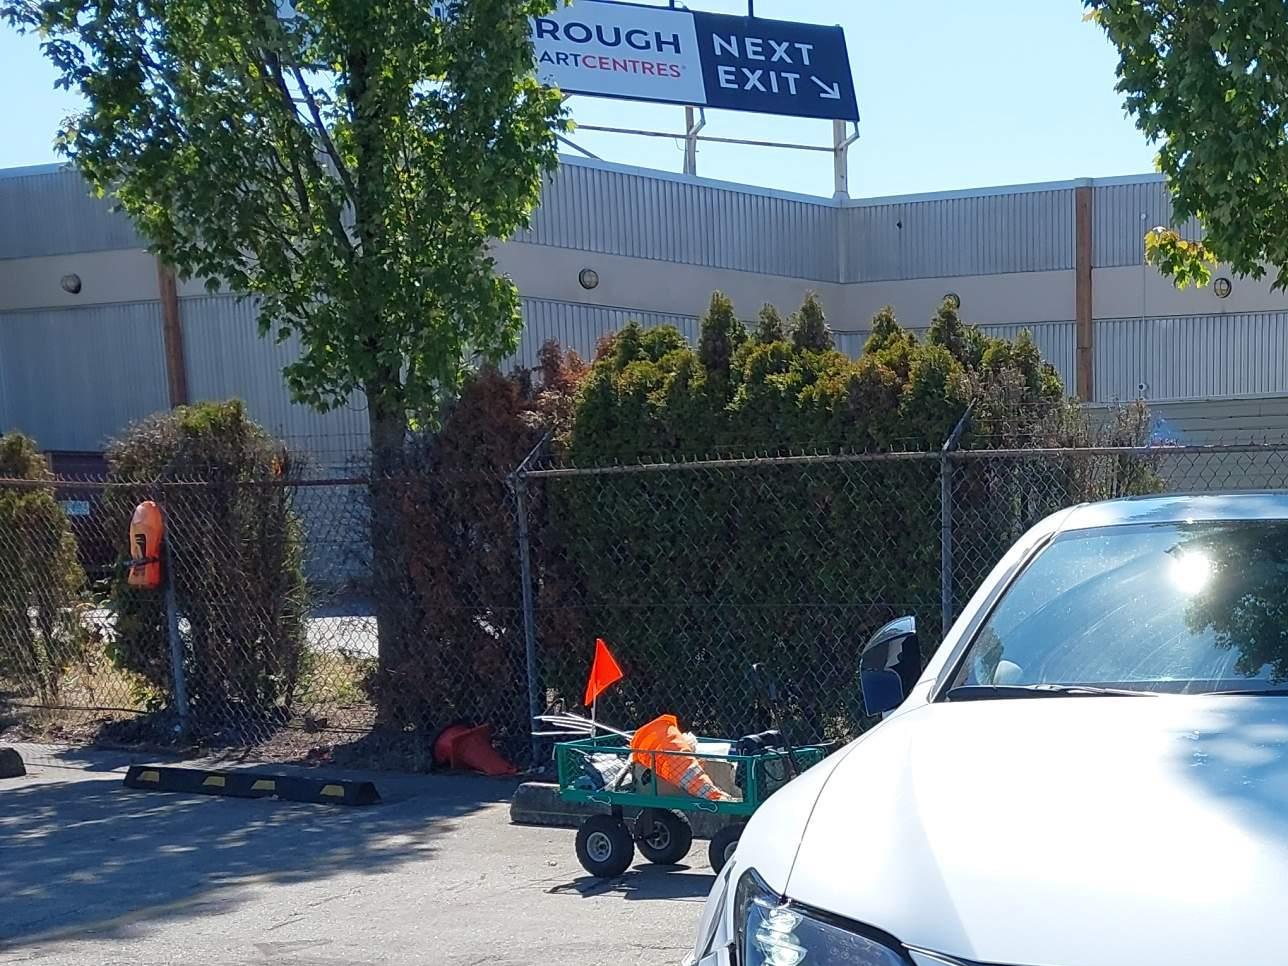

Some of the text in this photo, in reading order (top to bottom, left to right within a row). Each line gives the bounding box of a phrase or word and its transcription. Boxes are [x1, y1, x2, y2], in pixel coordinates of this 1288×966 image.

[527, 17, 682, 55] ROUGH
[711, 31, 814, 67] NEXT
[539, 50, 682, 79] ARTCENTRES
[716, 64, 802, 96] EXIT
